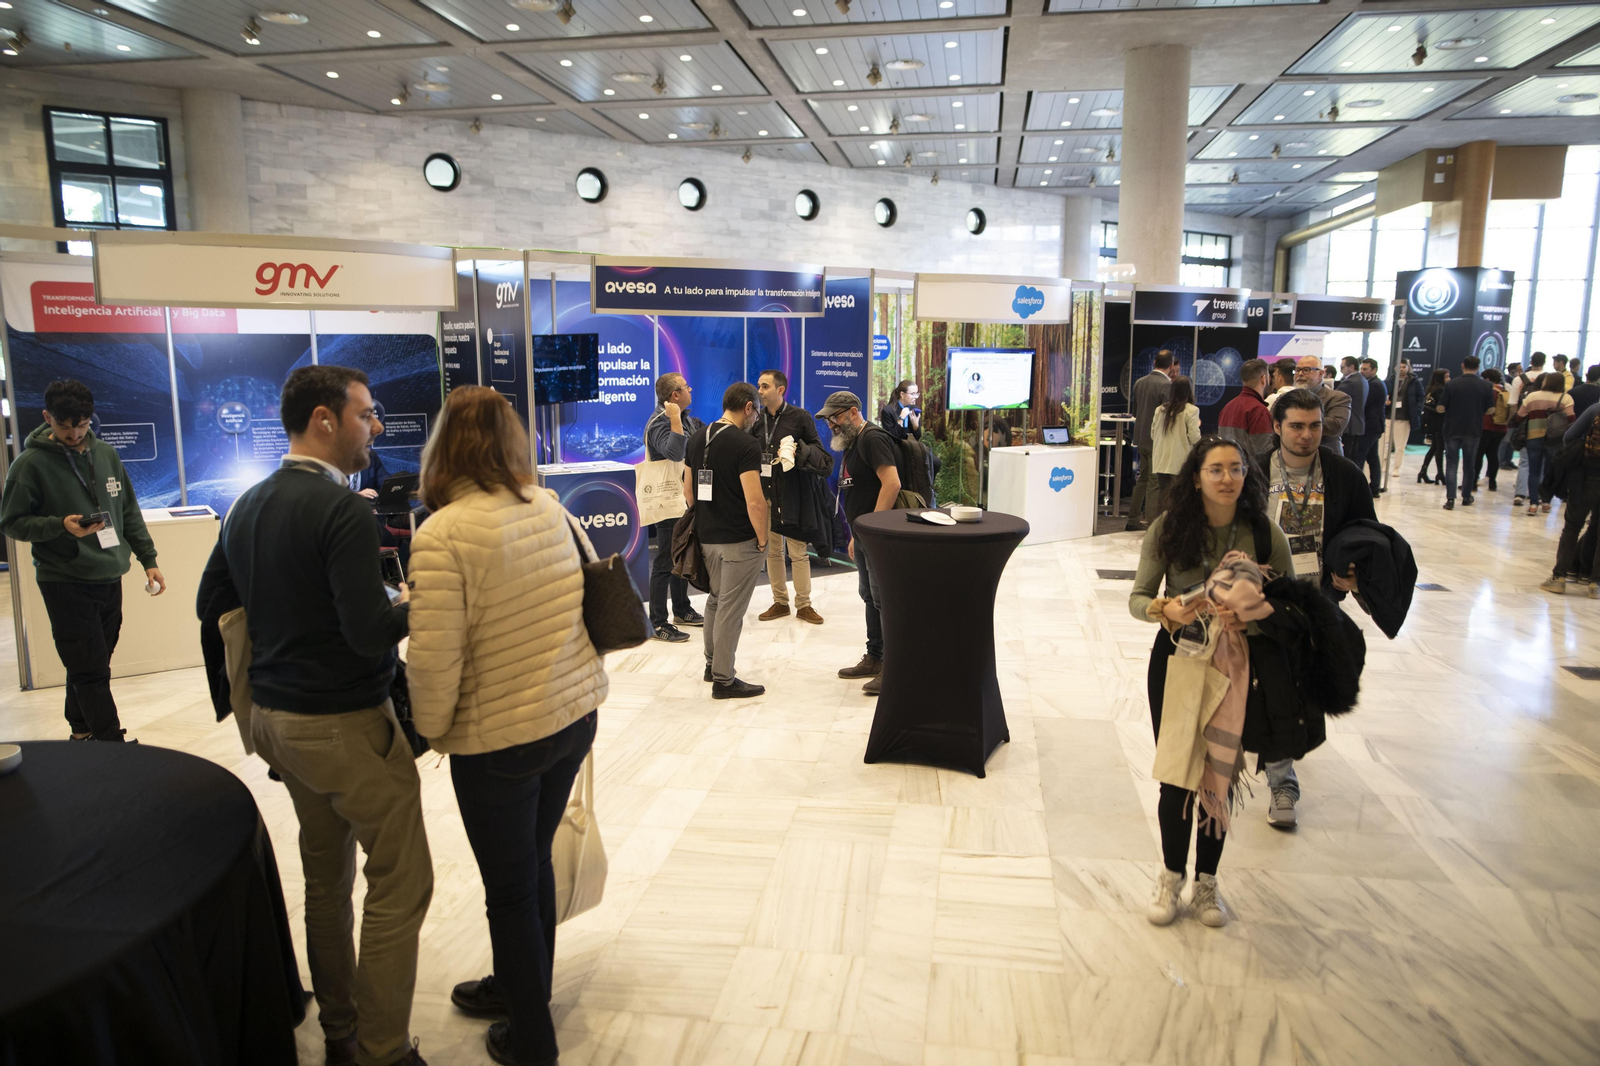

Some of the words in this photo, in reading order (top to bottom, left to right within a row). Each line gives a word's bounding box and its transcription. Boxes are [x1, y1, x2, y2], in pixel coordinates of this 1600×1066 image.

[254, 262, 340, 296] gmv
[496, 280, 519, 309] gmv
[605, 281, 657, 294] ayesa
[664, 285, 672, 294] A
[673, 286, 683, 295] tu
[684, 286, 703, 295] lado
[705, 288, 724, 297] para
[725, 287, 757, 298] impulsar
[757, 287, 764, 296] la
[765, 288, 805, 297] transformación
[1017, 297, 1043, 306] salesforce
[1213, 298, 1246, 312] trevenque
[44, 305, 112, 318] Inteligencia
[115, 307, 162, 317] Artificial
[172, 309, 179, 318] y
[182, 308, 199, 318] Big
[201, 308, 226, 317] Data
[1211, 312, 1227, 320] group
[607, 342, 632, 354] lado
[598, 358, 639, 373] mpulsar
[640, 358, 651, 370] la
[598, 374, 650, 387] ormación
[1101, 386, 1118, 394] DORES
[1051, 474, 1072, 482] salesforce
[575, 512, 628, 529] yesa
